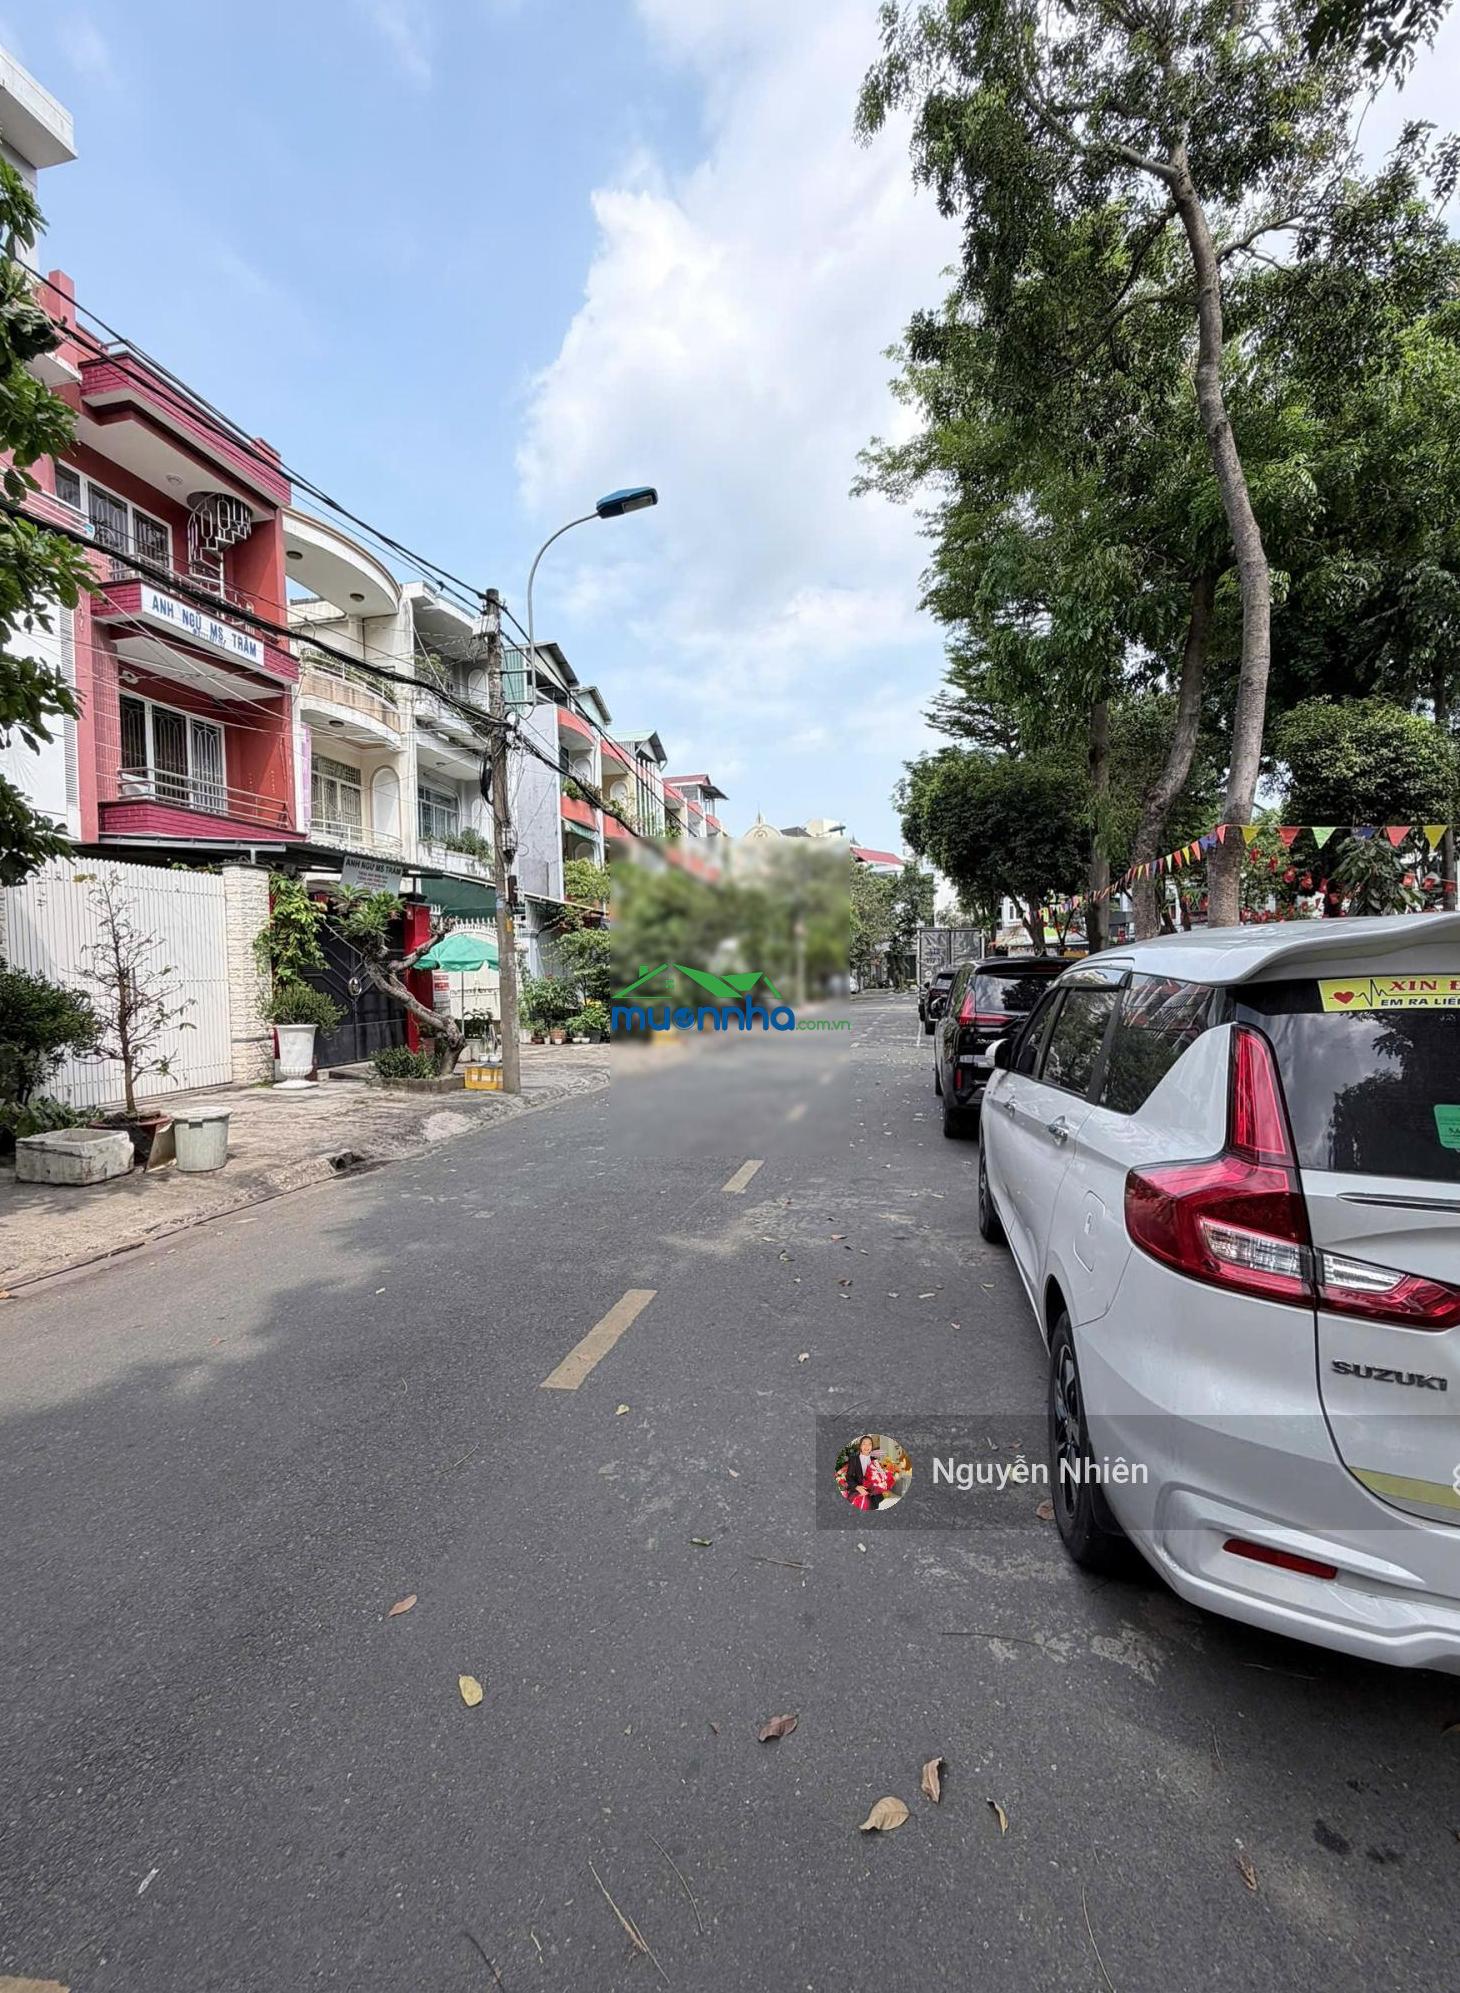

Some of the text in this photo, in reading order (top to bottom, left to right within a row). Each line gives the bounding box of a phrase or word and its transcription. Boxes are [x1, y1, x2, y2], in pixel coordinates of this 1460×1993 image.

[152, 594, 175, 618] ANH
[1389, 980, 1438, 991] XIN
[1381, 998, 1404, 1006] EM
[1408, 998, 1429, 1006] RA
[1331, 1360, 1448, 1392] SUZUKI
